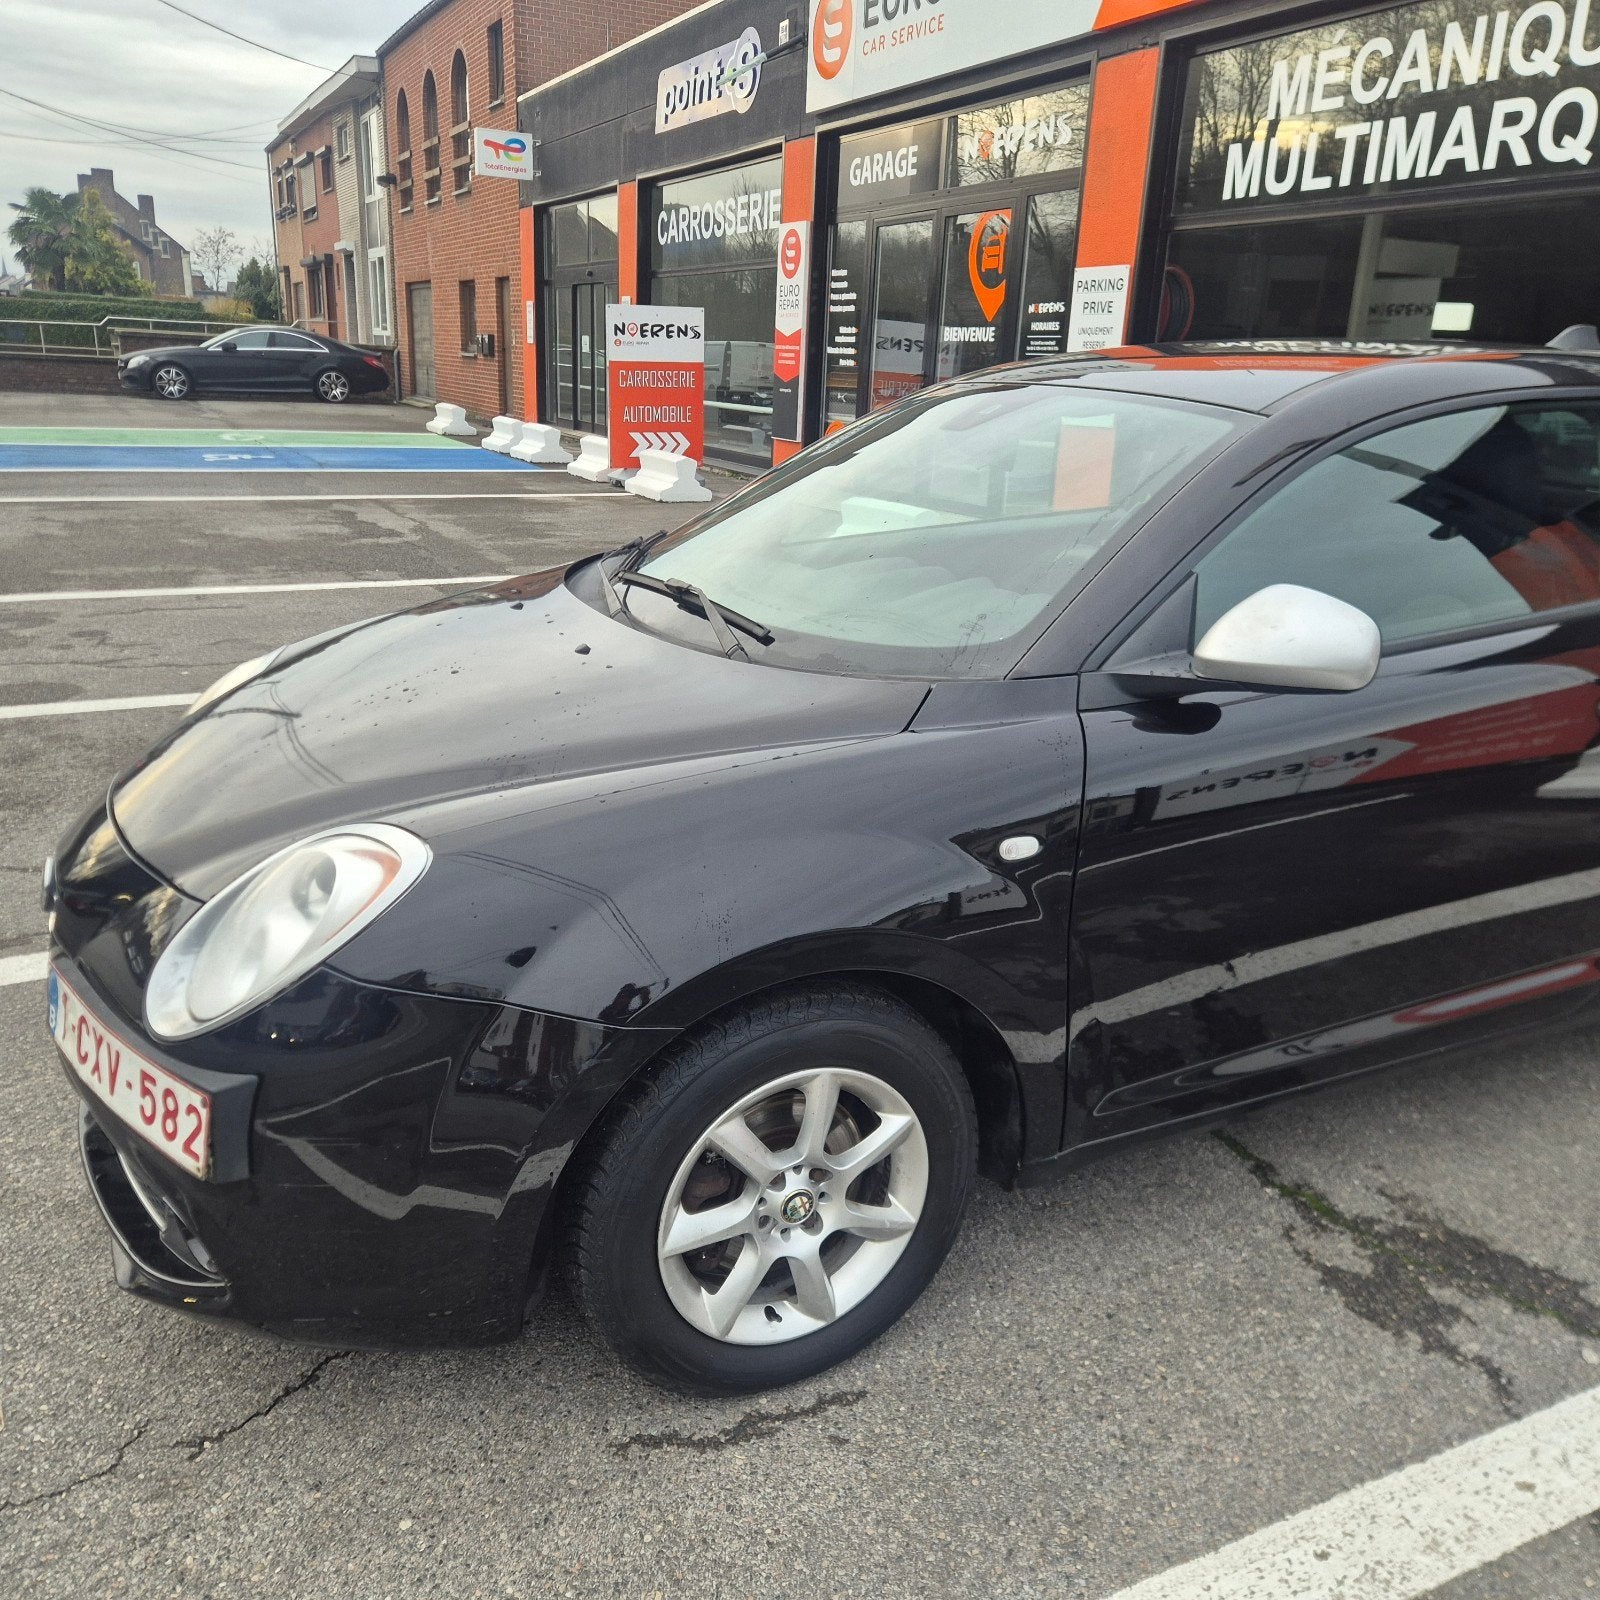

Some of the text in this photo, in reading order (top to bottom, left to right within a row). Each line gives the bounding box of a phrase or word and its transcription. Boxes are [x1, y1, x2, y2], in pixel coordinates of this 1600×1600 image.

[862, 34, 886, 57] CAR
[891, 13, 945, 47] SERVICE
[662, 58, 726, 125] point
[1222, 86, 1599, 201] MULTIMARQ
[484, 162, 527, 174] TotalEnergies
[850, 145, 919, 188] GARAGE
[657, 188, 782, 246] CARROSSERIE
[779, 284, 800, 298] EURO
[1076, 277, 1125, 293] PARKING
[778, 298, 800, 310] REPAR
[1082, 300, 1115, 314] PRIVE
[943, 326, 996, 343] BIENVENUE
[1077, 327, 1114, 337] UNIQUEMENT
[619, 370, 697, 388] CARROSSERIE
[623, 405, 693, 423] AUTOMOBILE
